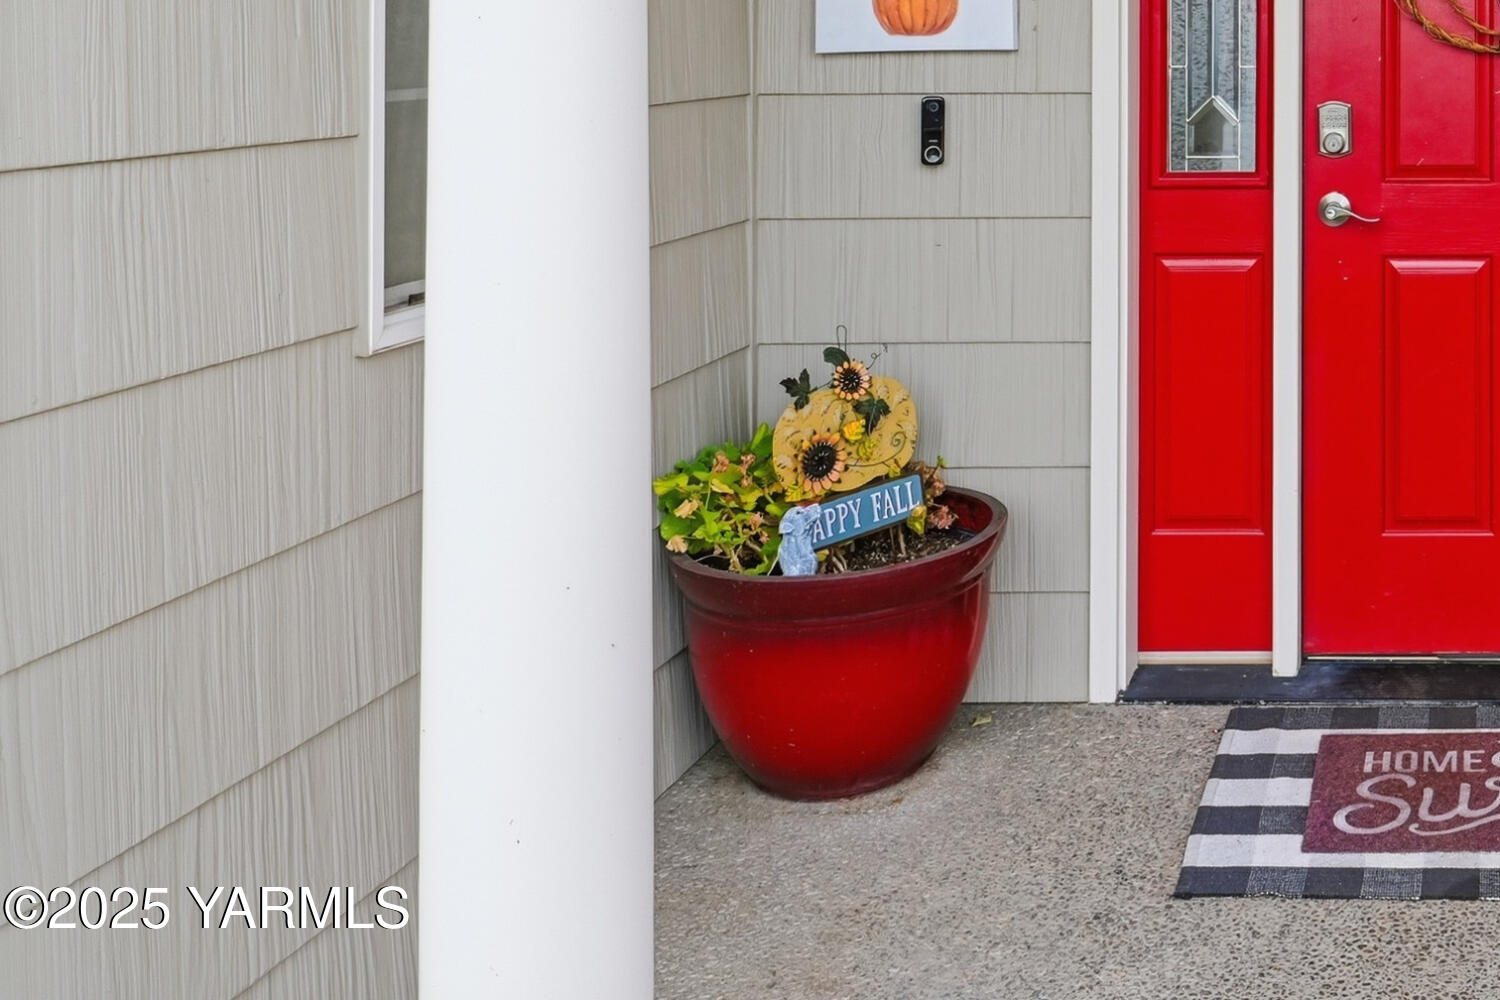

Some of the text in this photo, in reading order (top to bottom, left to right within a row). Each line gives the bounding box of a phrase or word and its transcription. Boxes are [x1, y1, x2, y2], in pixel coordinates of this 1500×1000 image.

[812, 481, 920, 543] APPY FALL
[1363, 750, 1488, 773] HOME
